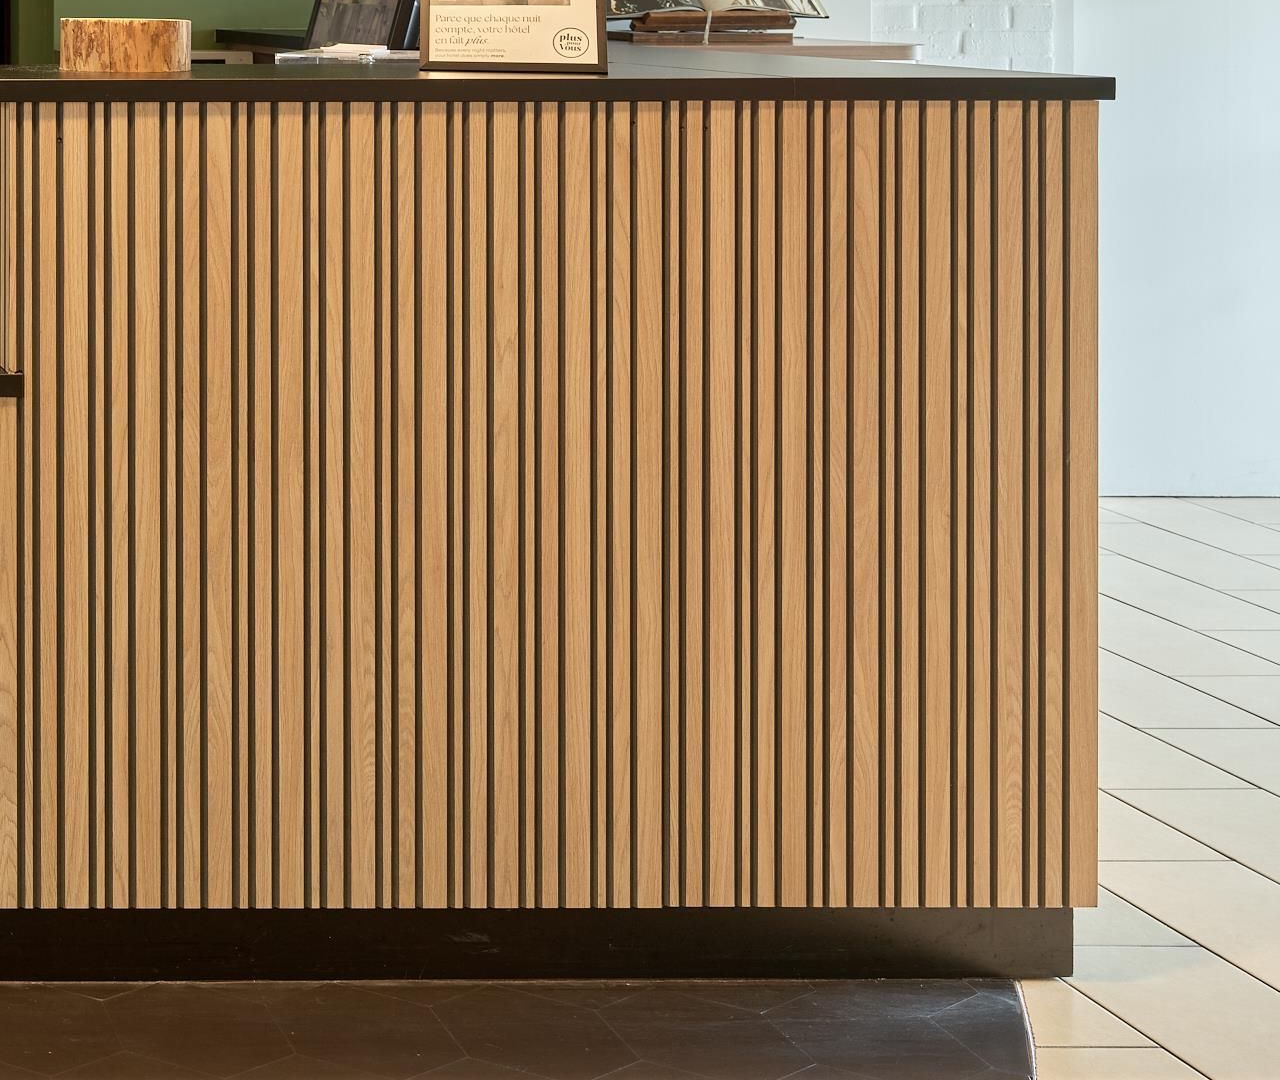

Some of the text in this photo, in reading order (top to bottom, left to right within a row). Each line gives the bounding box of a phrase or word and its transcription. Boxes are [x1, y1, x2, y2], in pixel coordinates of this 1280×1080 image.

[435, 13, 541, 25] Parce que chaque nuit
[505, 24, 530, 33] hôtel
[449, 36, 463, 44] fait
[559, 33, 582, 42] plus
[559, 43, 582, 51] Vous
